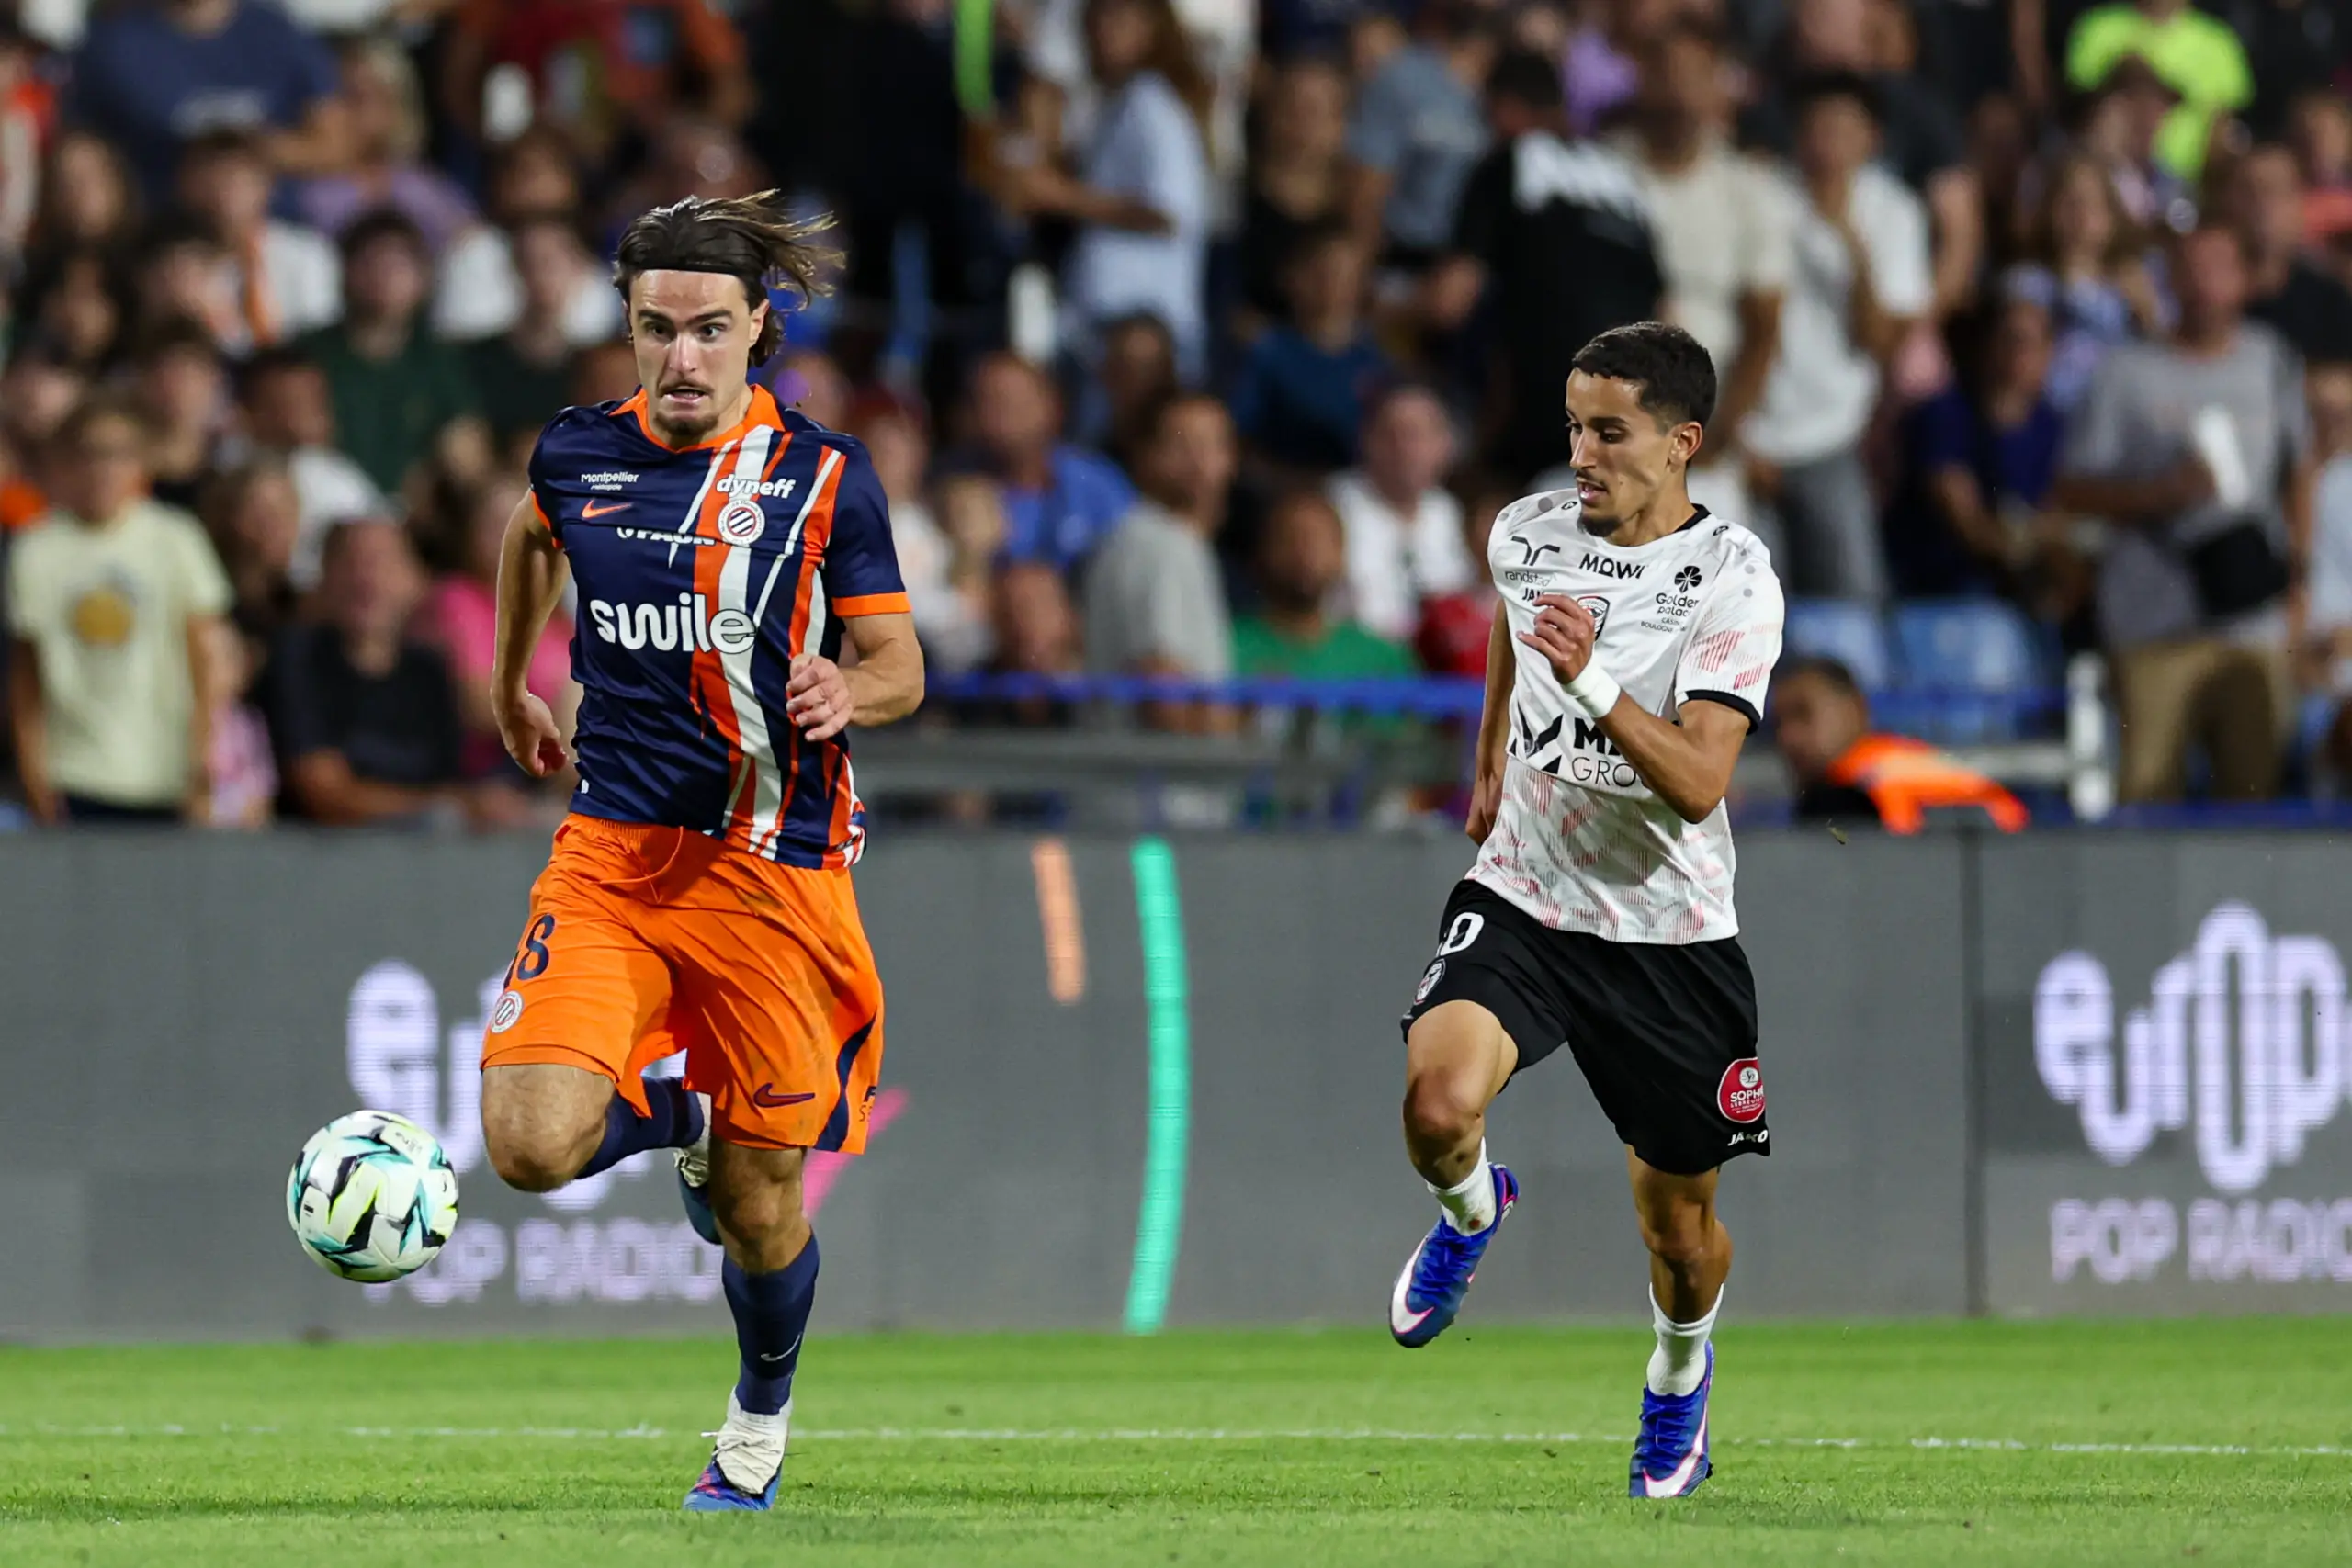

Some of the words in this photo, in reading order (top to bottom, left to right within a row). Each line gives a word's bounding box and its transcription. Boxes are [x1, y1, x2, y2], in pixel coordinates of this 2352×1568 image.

[716, 474, 796, 499] dyneff
[590, 592, 757, 654] swile
[1657, 606, 1691, 617] palac
[2051, 1199, 2178, 1283] POP
